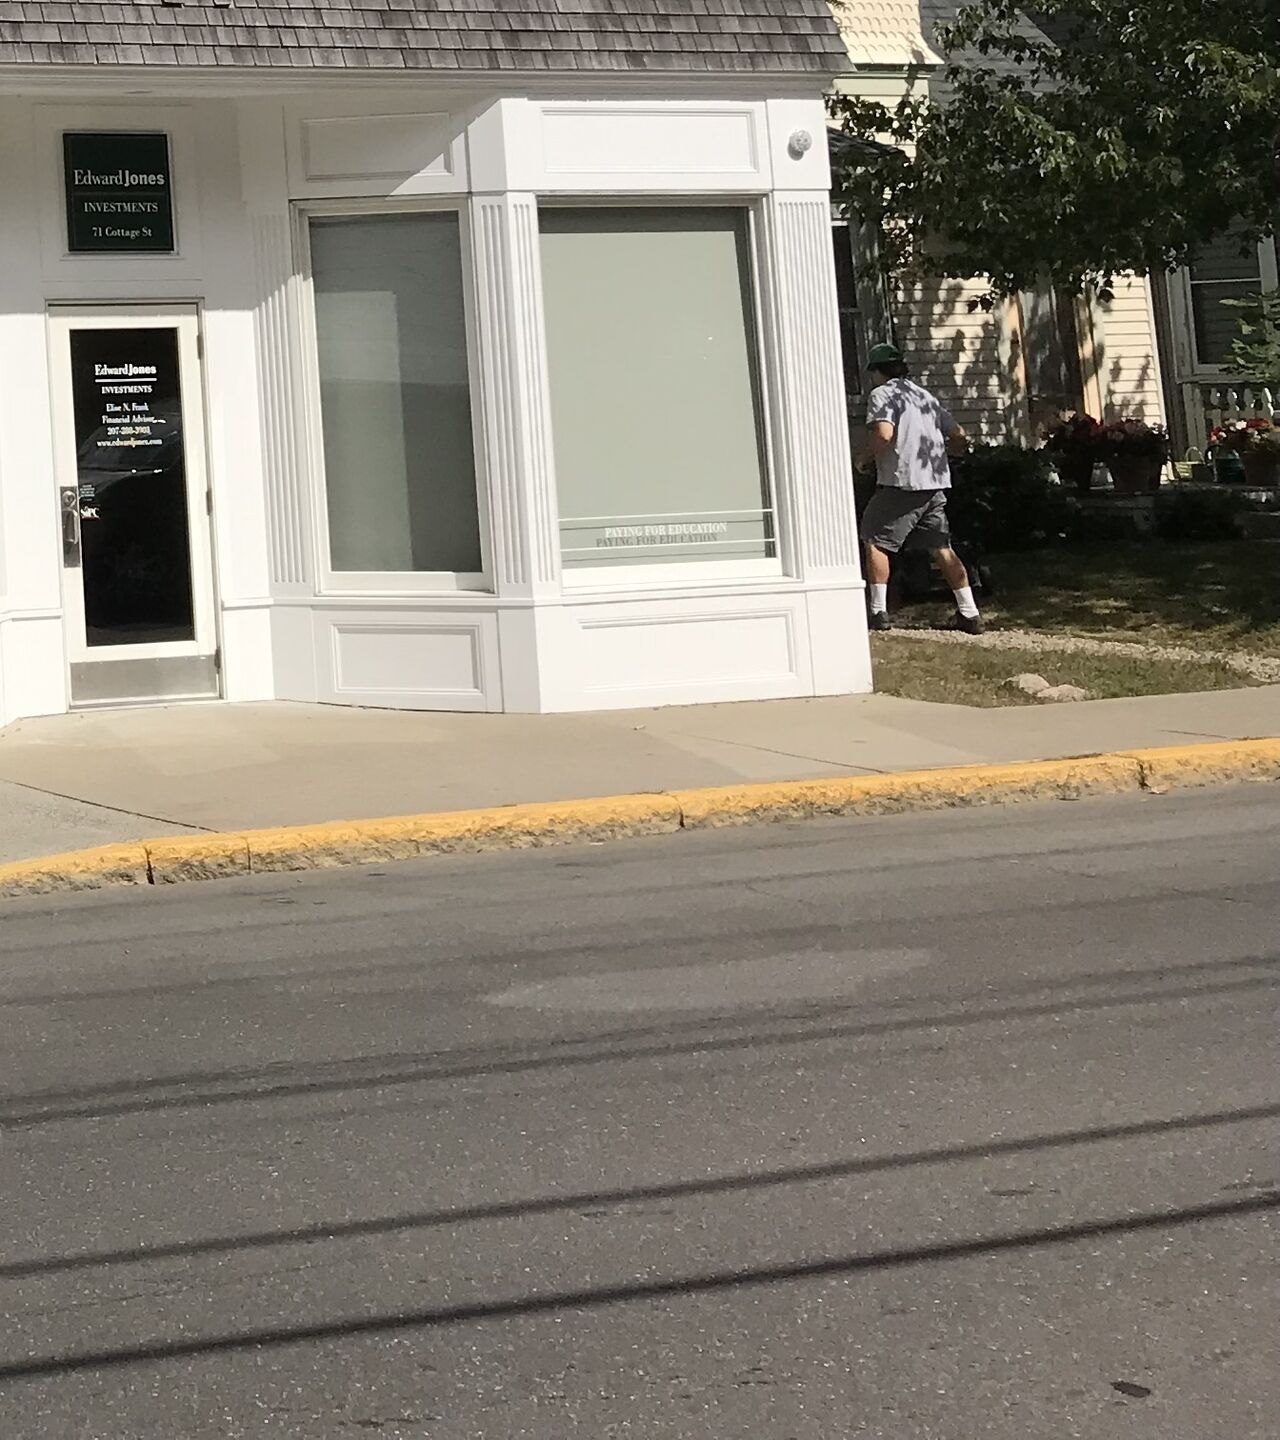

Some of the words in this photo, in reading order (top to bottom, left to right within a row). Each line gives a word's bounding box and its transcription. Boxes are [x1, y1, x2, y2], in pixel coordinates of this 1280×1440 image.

[84, 202, 159, 213] INVESTMENTS
[92, 226, 102, 237] 71
[105, 226, 140, 239] Cottage
[142, 226, 153, 237] St
[101, 385, 153, 394] INVESTMENTS
[102, 415, 130, 424] Financial
[605, 526, 642, 538] PAYING
[644, 524, 666, 536] FOR
[668, 522, 728, 535] EDUCATION
